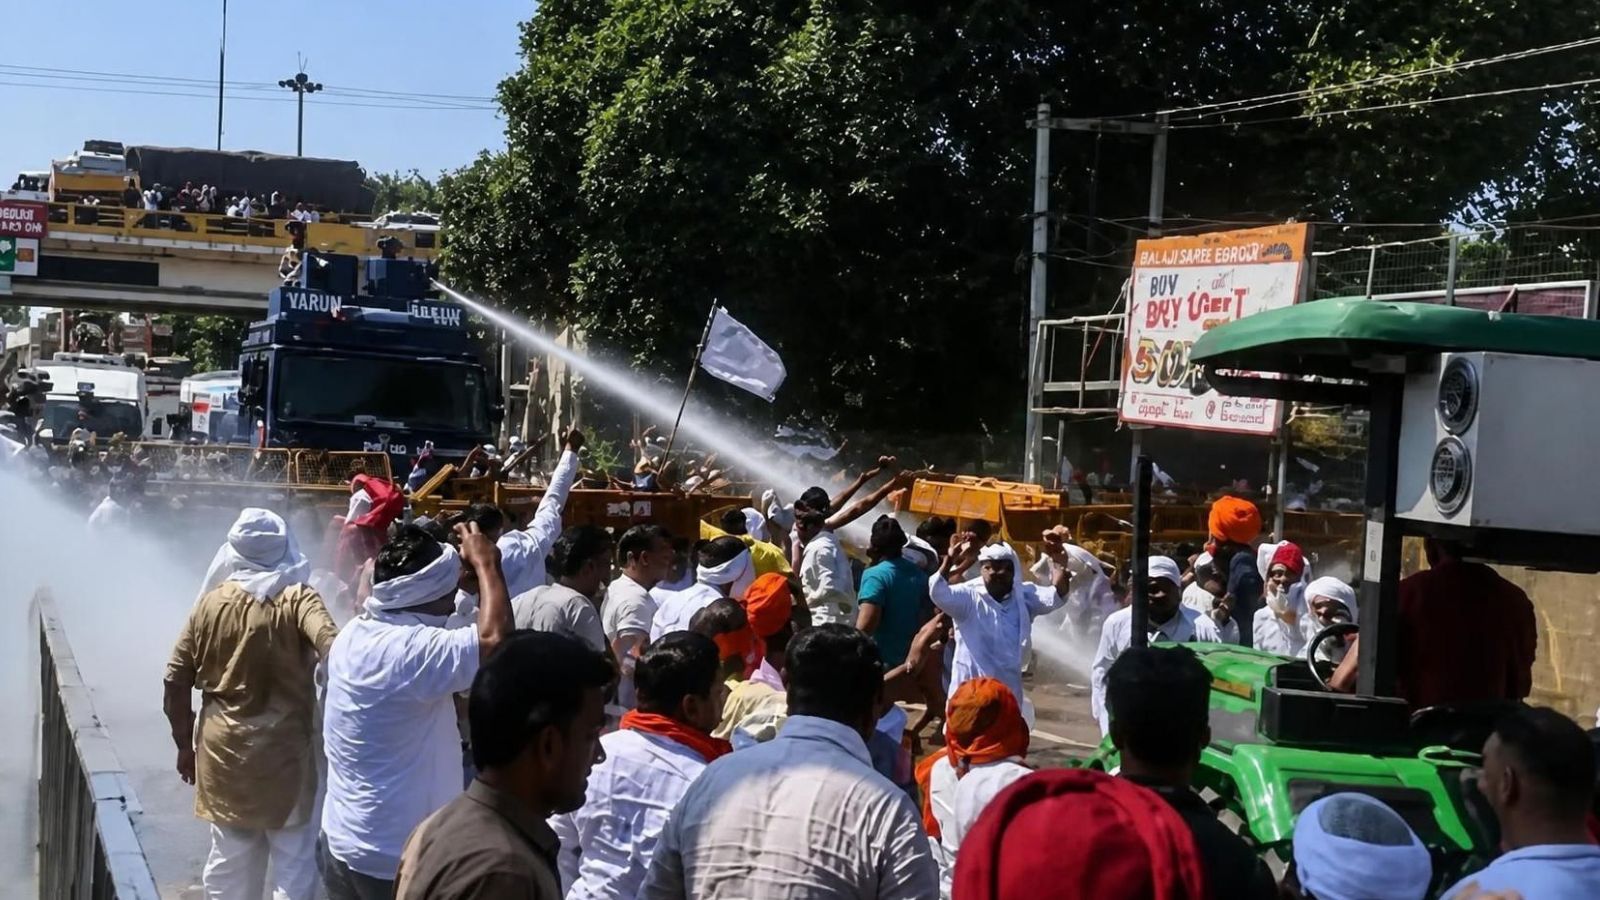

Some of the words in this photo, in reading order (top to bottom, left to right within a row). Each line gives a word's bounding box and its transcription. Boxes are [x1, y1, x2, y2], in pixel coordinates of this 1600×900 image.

[1140, 249, 1178, 266] BALAJI
[1179, 247, 1212, 265] SAREE
[1150, 274, 1179, 298] BUY
[287, 291, 342, 313] VARUN
